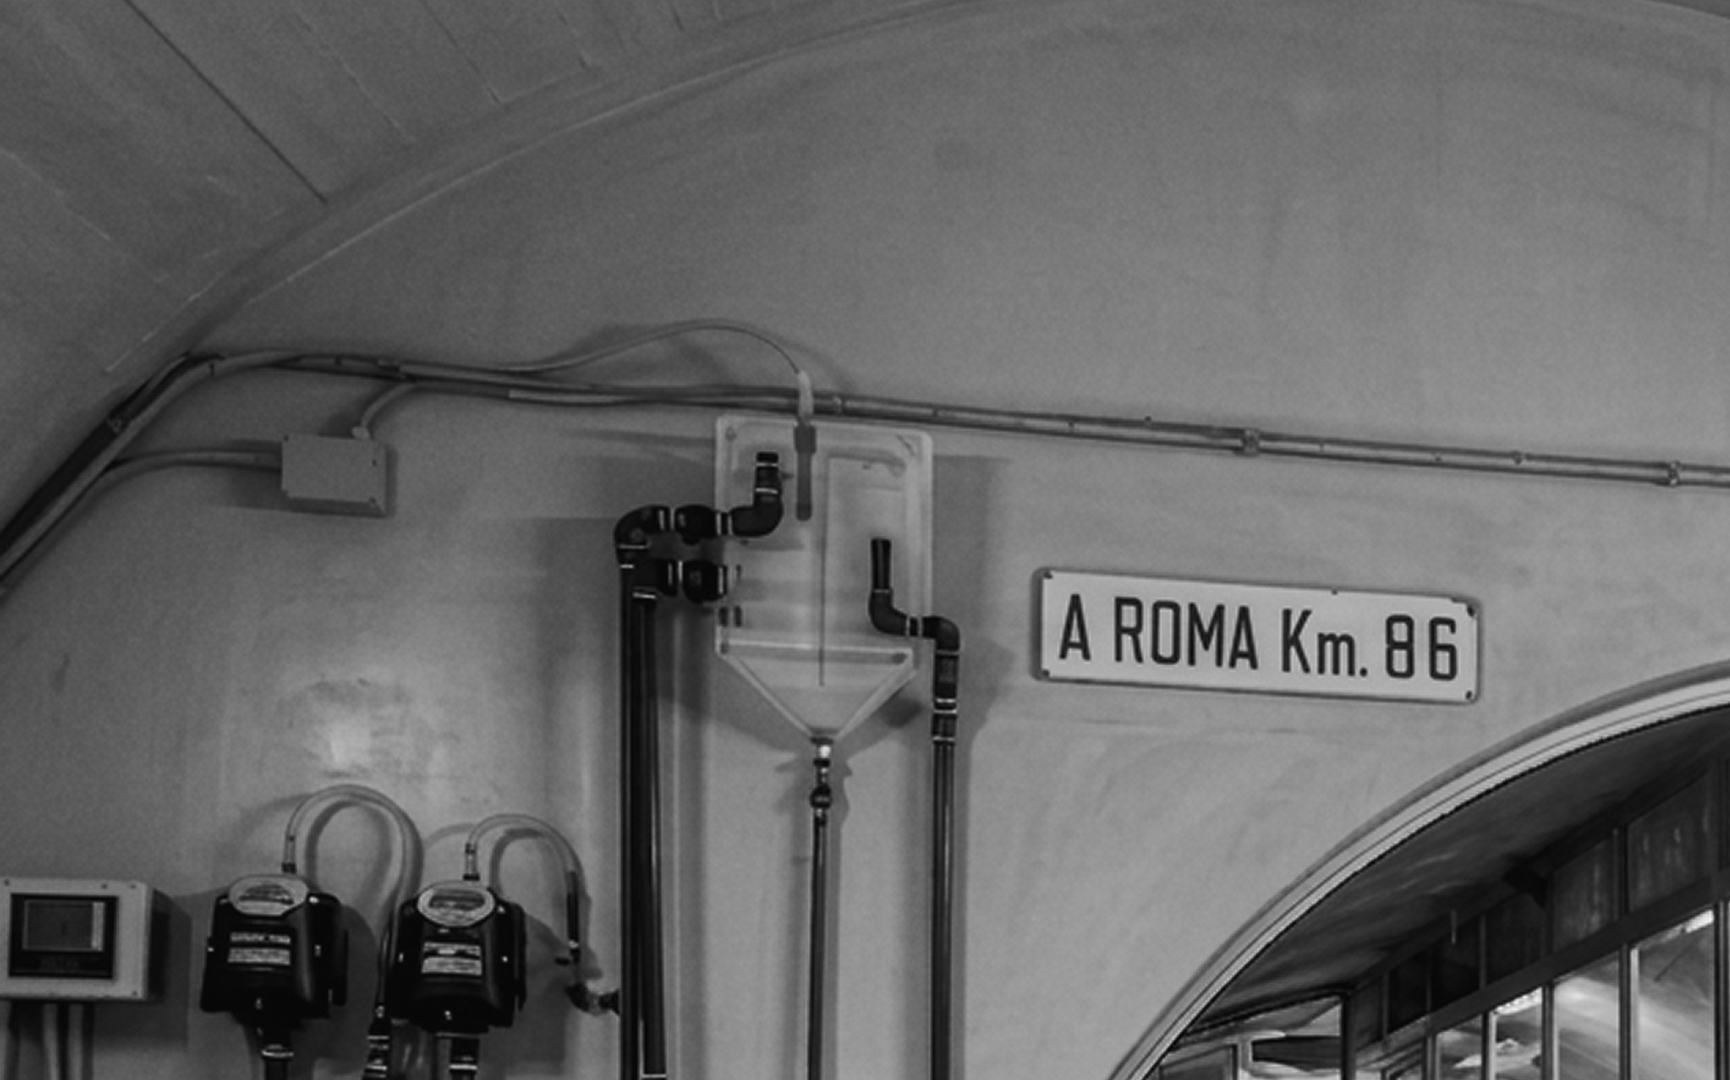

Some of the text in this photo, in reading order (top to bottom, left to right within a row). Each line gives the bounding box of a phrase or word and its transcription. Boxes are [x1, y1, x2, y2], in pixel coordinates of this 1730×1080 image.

[1058, 593, 1458, 682] A ROMA Km. 86
